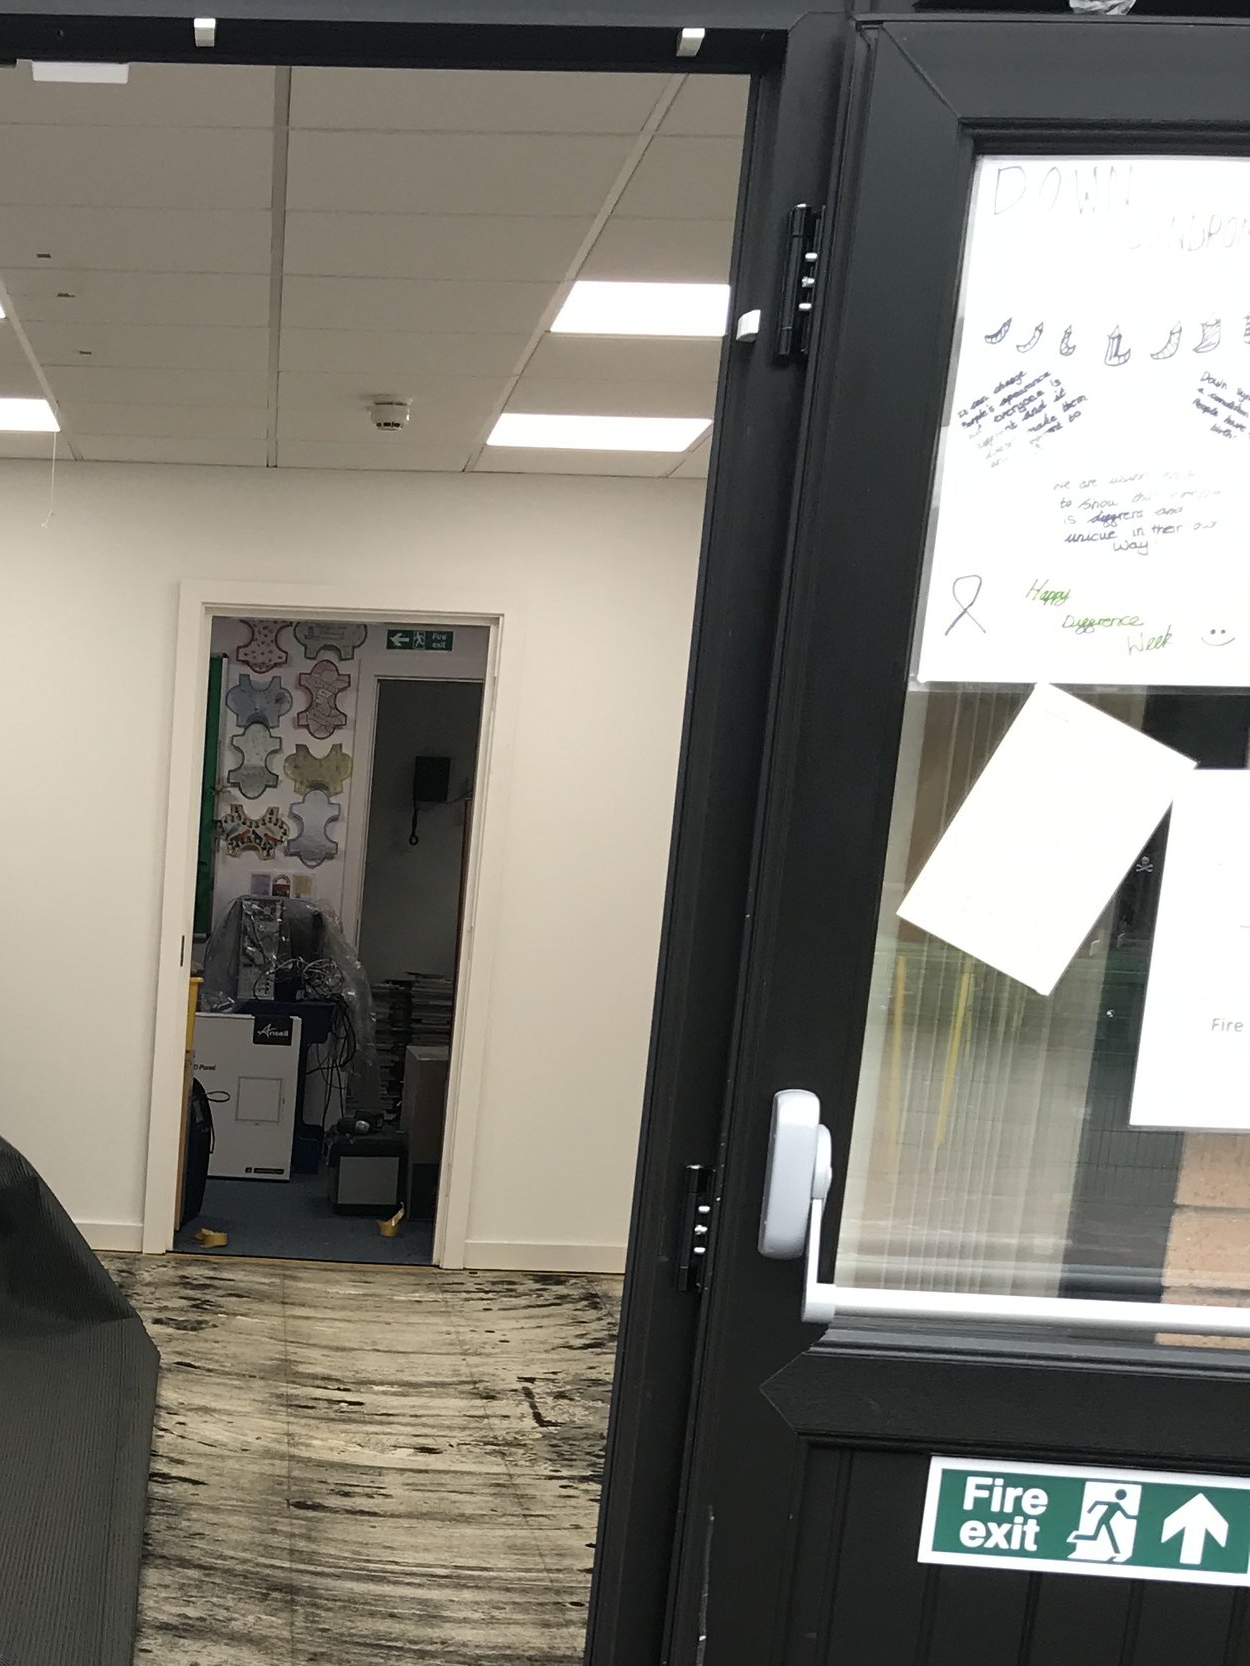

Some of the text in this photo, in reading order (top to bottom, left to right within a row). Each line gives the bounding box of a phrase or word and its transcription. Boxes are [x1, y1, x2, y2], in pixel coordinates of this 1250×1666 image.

[1132, 525, 1145, 538] in
[1025, 578, 1071, 607] Happy
[1211, 1017, 1244, 1033] Fire
[963, 1476, 1049, 1516] Fire
[959, 1516, 1041, 1552] exit
